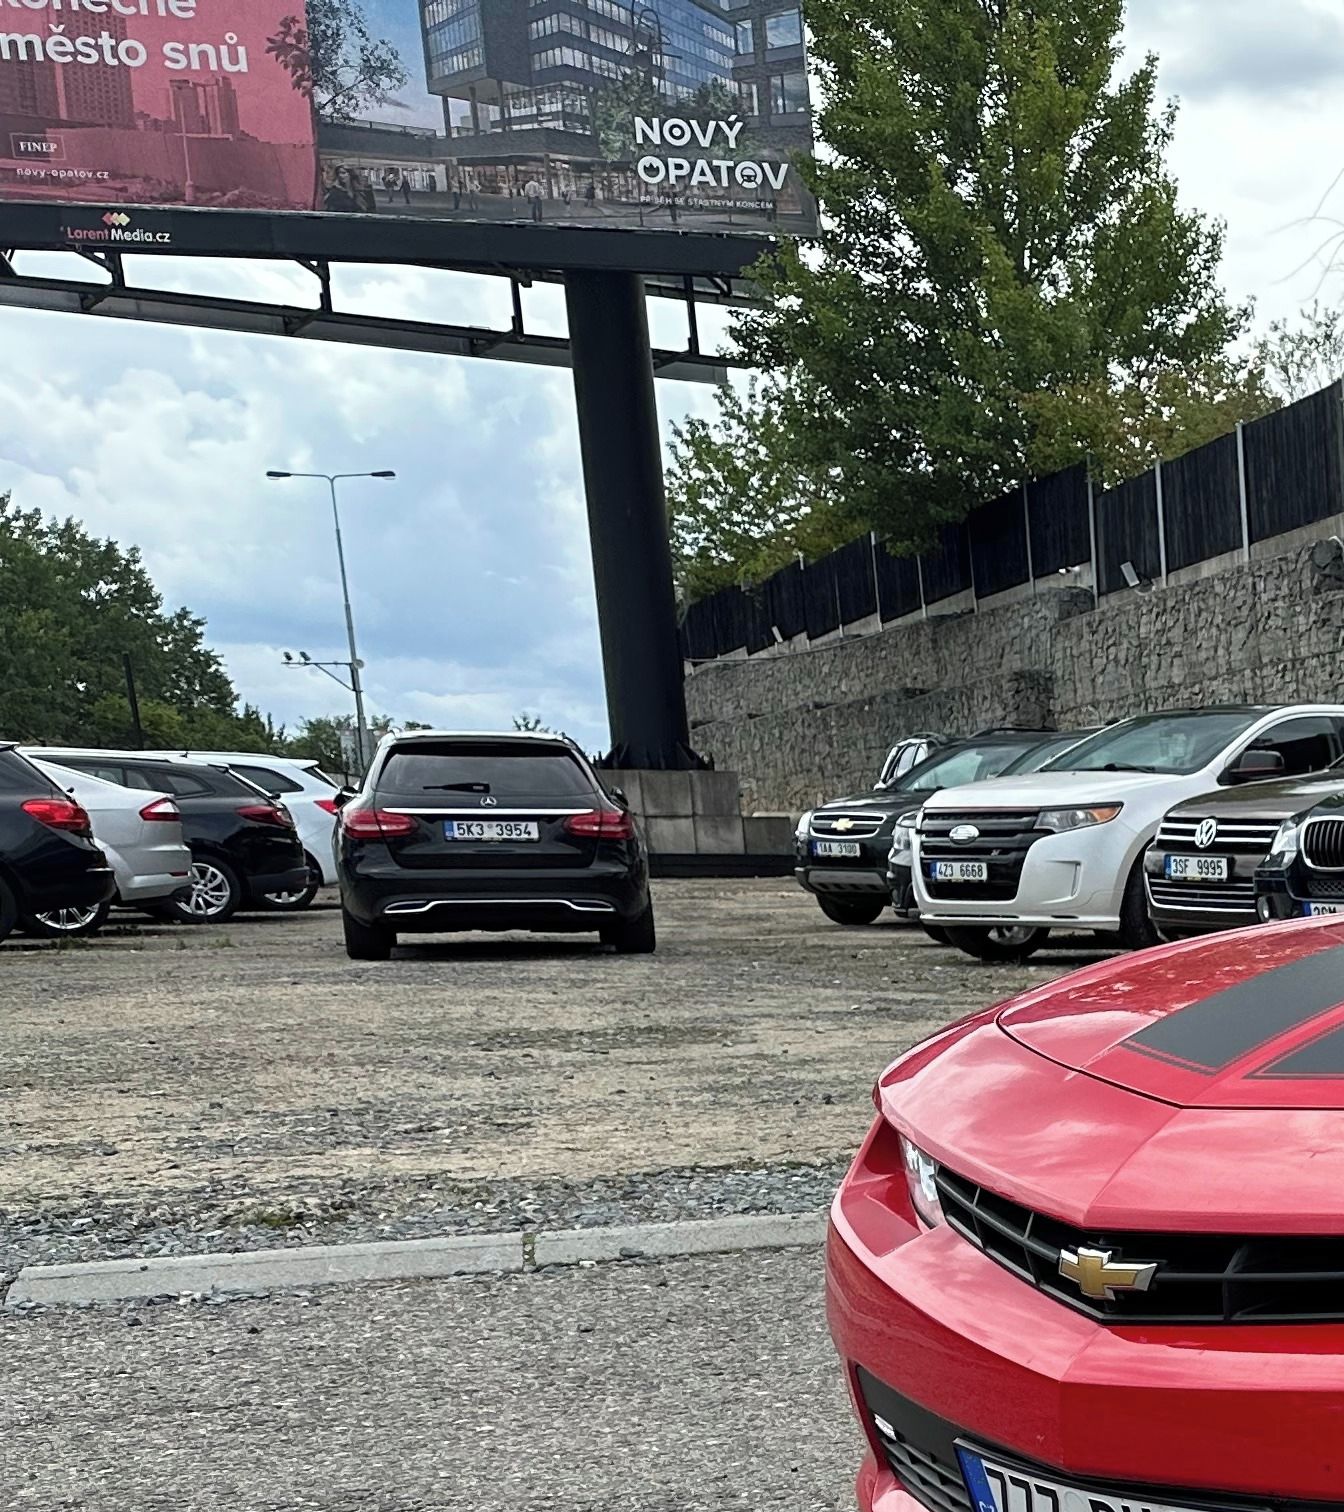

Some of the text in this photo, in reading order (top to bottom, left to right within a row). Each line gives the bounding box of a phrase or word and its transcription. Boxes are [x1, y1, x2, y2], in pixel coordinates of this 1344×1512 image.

[0, 24, 249, 73] město snů
[634, 114, 744, 149] NOVÝ
[19, 141, 57, 153] FINEP
[637, 155, 789, 190] OPATOV
[456, 823, 532, 836] 5K3 3954
[938, 862, 953, 877] 4Z3
[1172, 858, 1189, 875] 3SF
